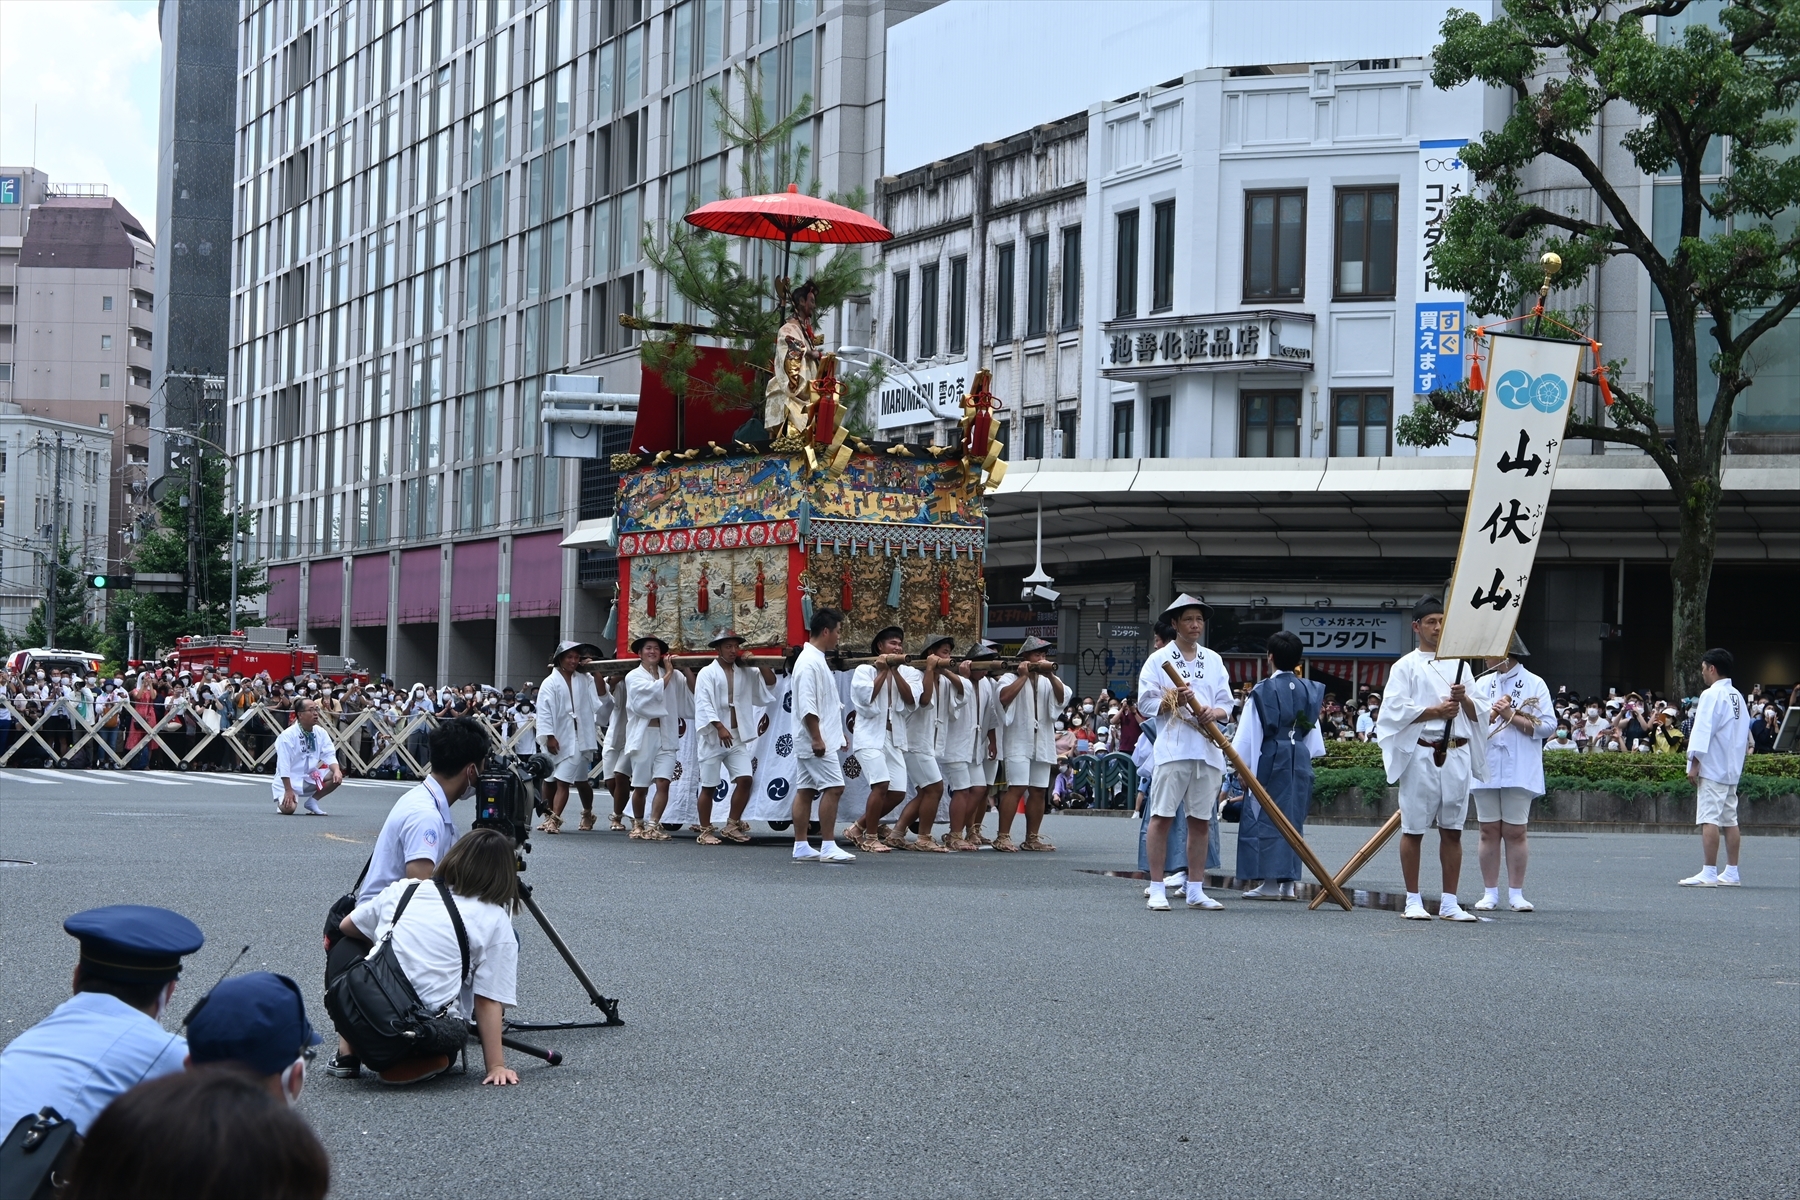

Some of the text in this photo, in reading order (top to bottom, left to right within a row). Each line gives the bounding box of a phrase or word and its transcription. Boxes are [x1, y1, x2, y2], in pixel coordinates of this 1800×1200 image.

[1110, 325, 1259, 364] 池善化粧品店
[1441, 312, 1458, 353] すぐ
[1419, 311, 1438, 391] 買えます
[938, 376, 965, 405] 雲の茶
[1542, 438, 1558, 475] やま
[1470, 428, 1542, 611] 山伏山
[1512, 574, 1528, 608] やま
[1025, 627, 1058, 637] ACCESS TICKET
[1111, 629, 1140, 637] コンタクト
[1328, 618, 1387, 627] メガネスーパー
[1299, 631, 1387, 649] コンタクト
